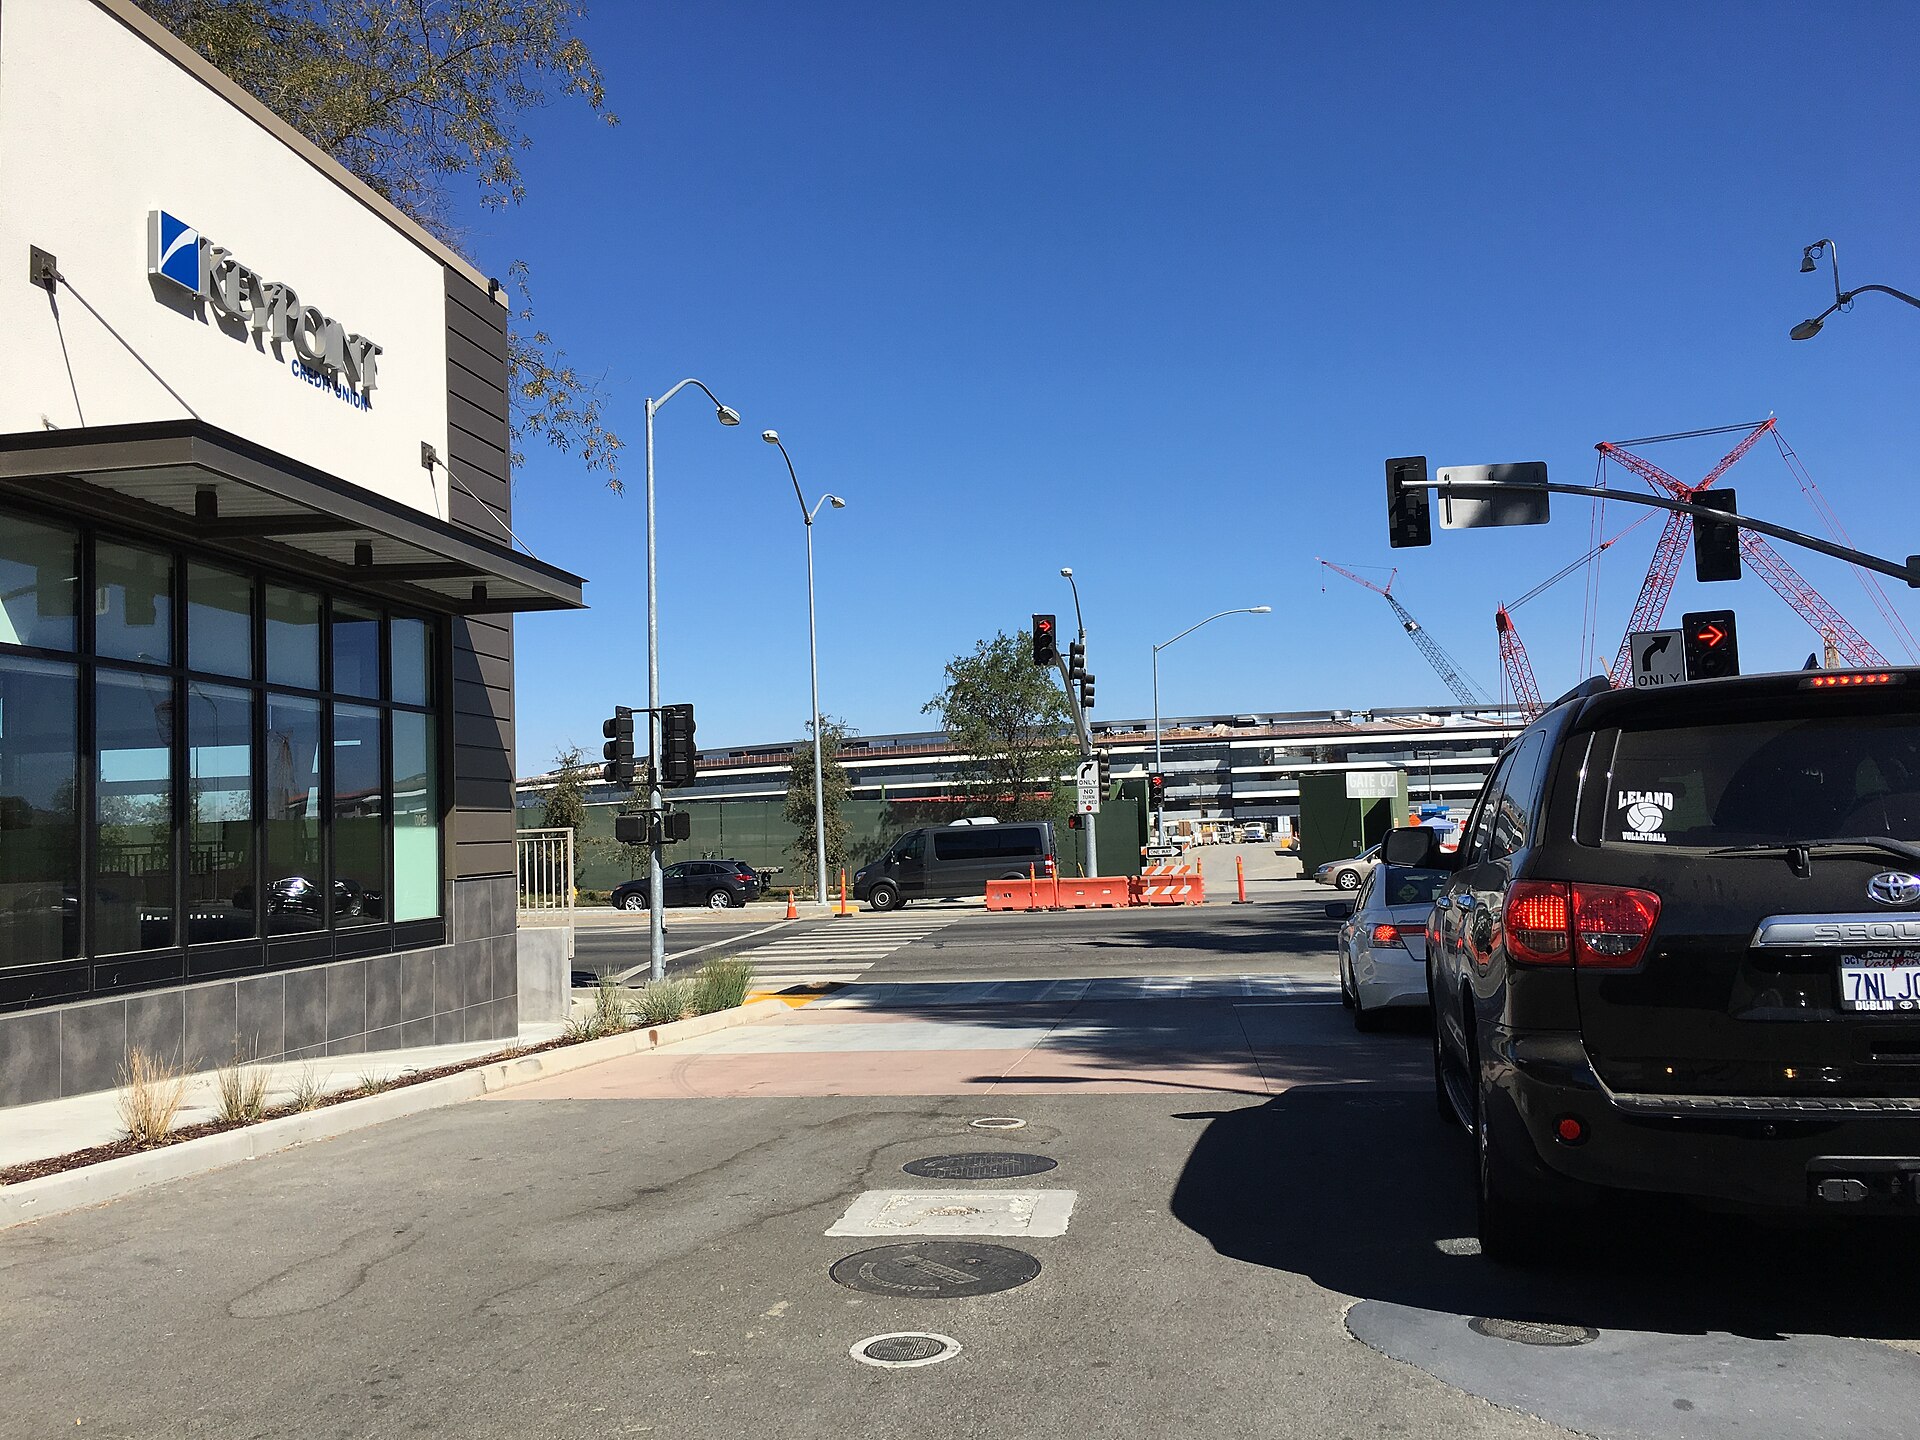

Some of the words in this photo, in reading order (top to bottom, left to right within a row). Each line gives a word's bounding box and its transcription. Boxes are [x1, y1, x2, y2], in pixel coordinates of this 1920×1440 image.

[291, 359, 331, 394] CREDIT
[334, 383, 368, 412] UNION
[1638, 673, 1680, 687] ONLY
[1350, 773, 1375, 788] GATE
[1380, 773, 1395, 787] 02
[1617, 790, 1673, 811] LELAND
[1622, 831, 1667, 842] VOLLEYBALL
[1855, 1000, 1894, 1011] DUBLIN
